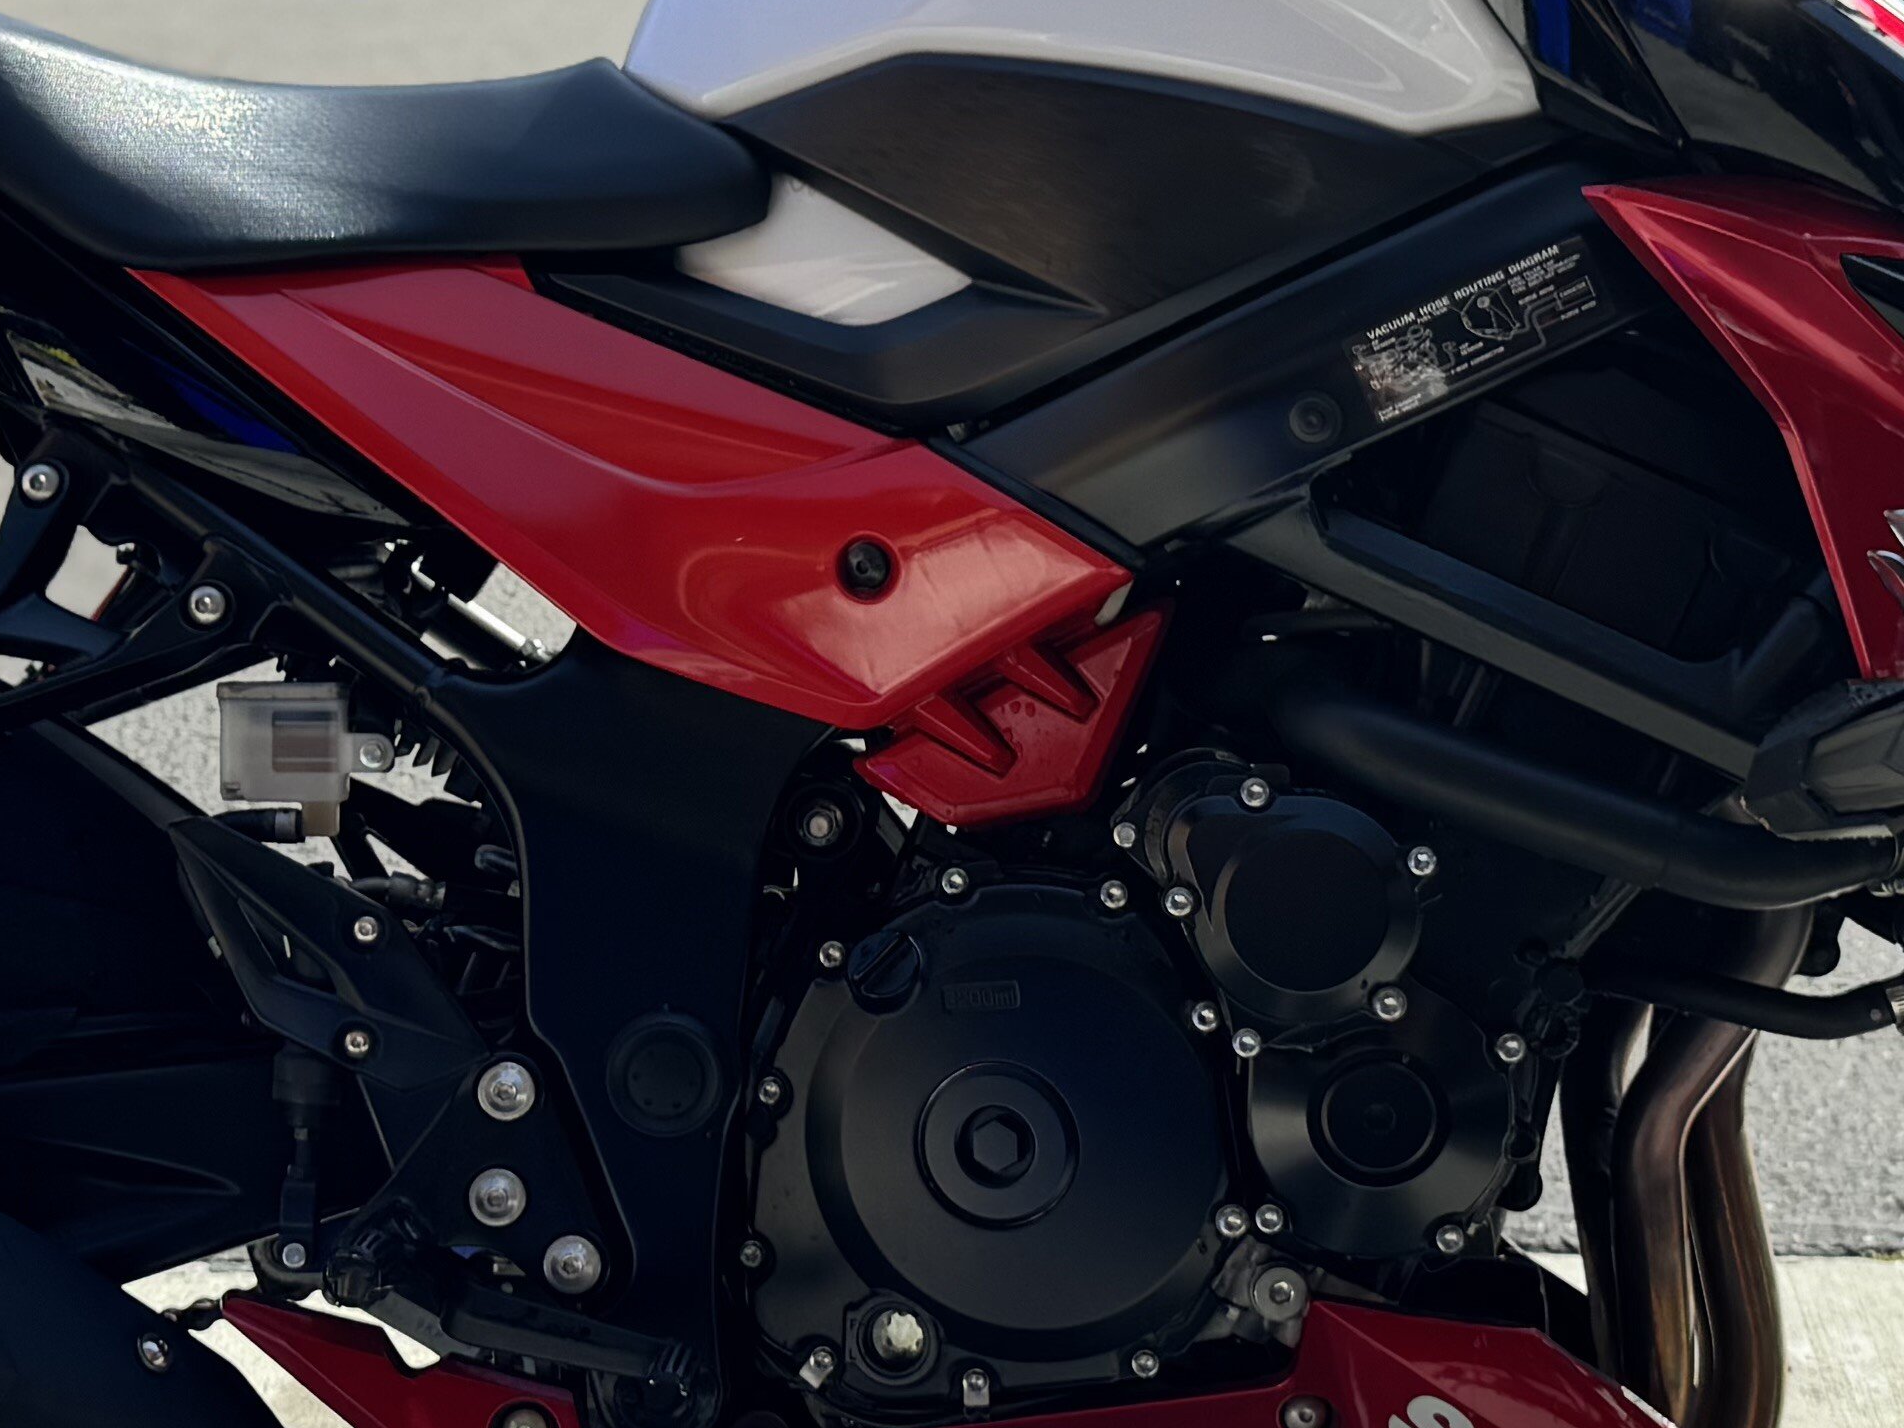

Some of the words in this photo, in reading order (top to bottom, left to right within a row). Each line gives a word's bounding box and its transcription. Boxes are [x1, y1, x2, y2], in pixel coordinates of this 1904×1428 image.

[1367, 313, 1416, 339] VACUUM
[1418, 295, 1450, 319] HOSE
[1454, 271, 1505, 300] ROUTING
[1508, 245, 1558, 274] DIAGRAM
